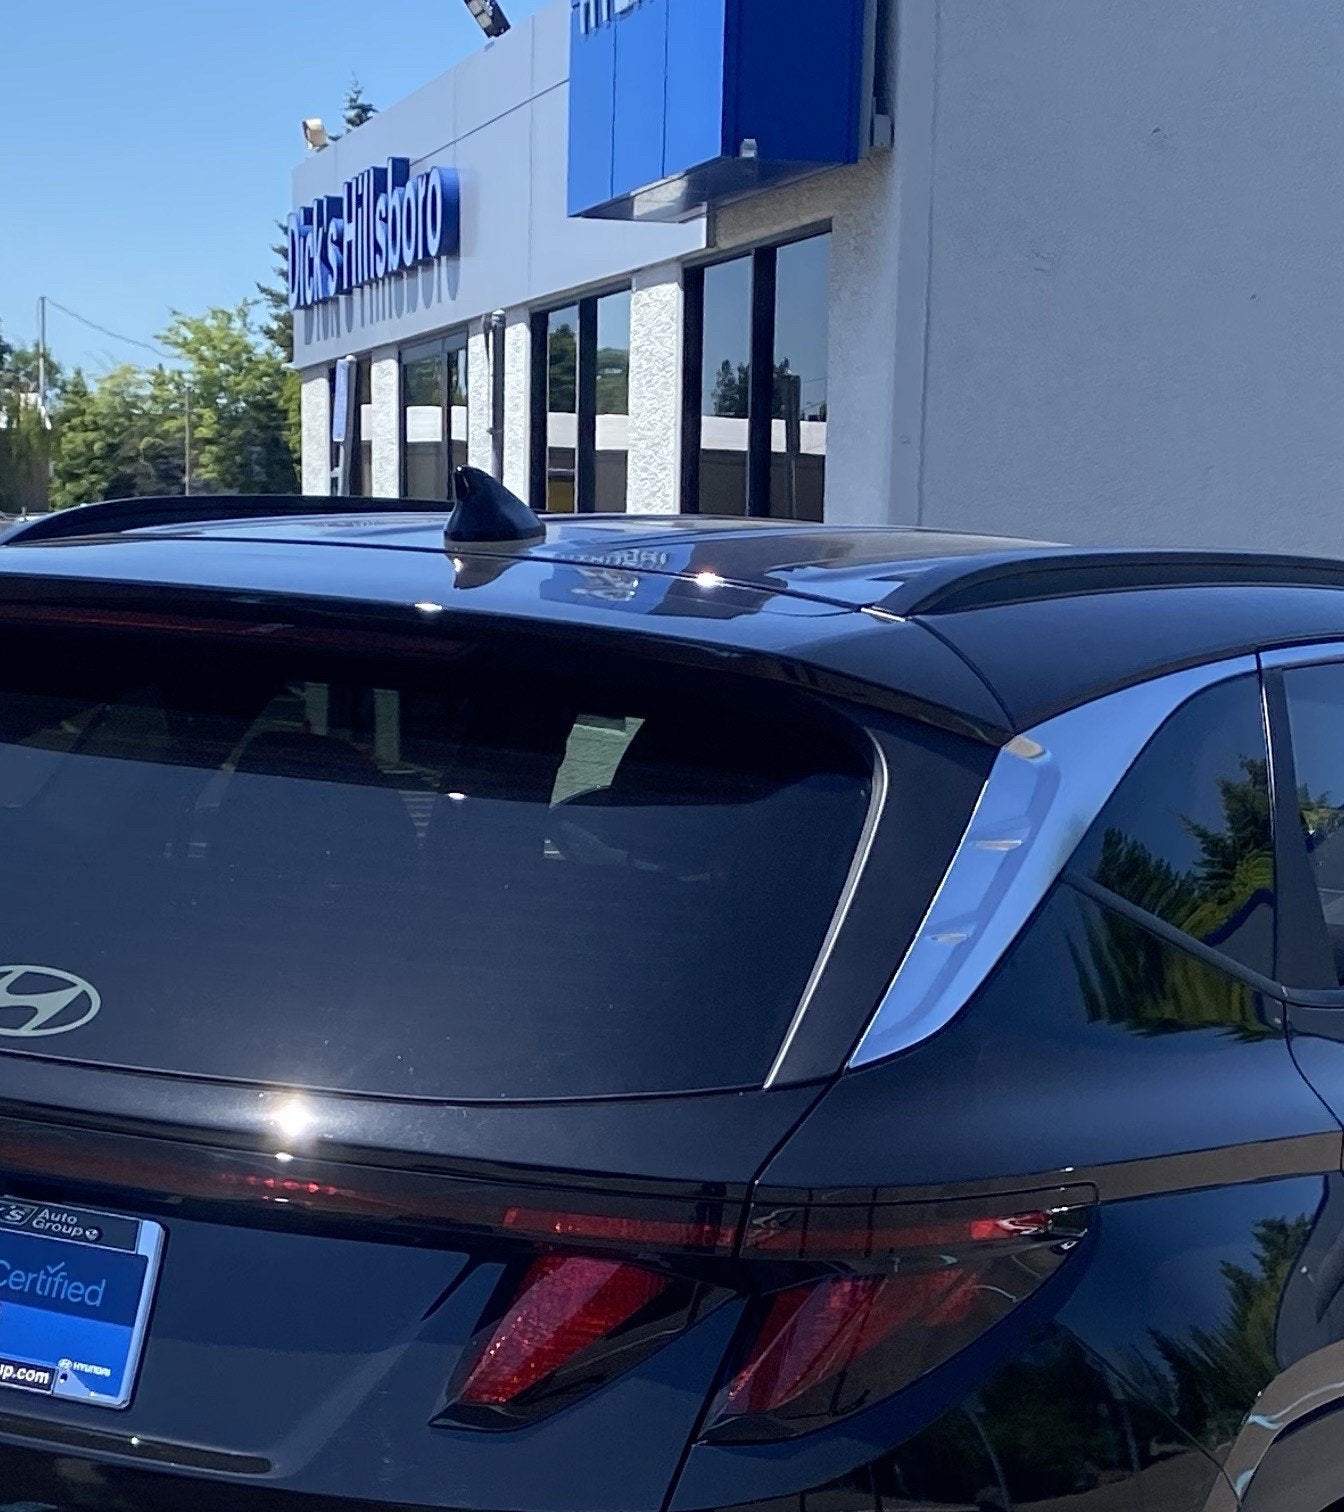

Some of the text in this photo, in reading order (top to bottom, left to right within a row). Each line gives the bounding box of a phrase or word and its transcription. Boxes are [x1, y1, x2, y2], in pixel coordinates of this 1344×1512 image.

[288, 157, 448, 311] Dick's Hillsboro
[38, 1208, 78, 1224] Auto
[31, 1218, 84, 1237] Group
